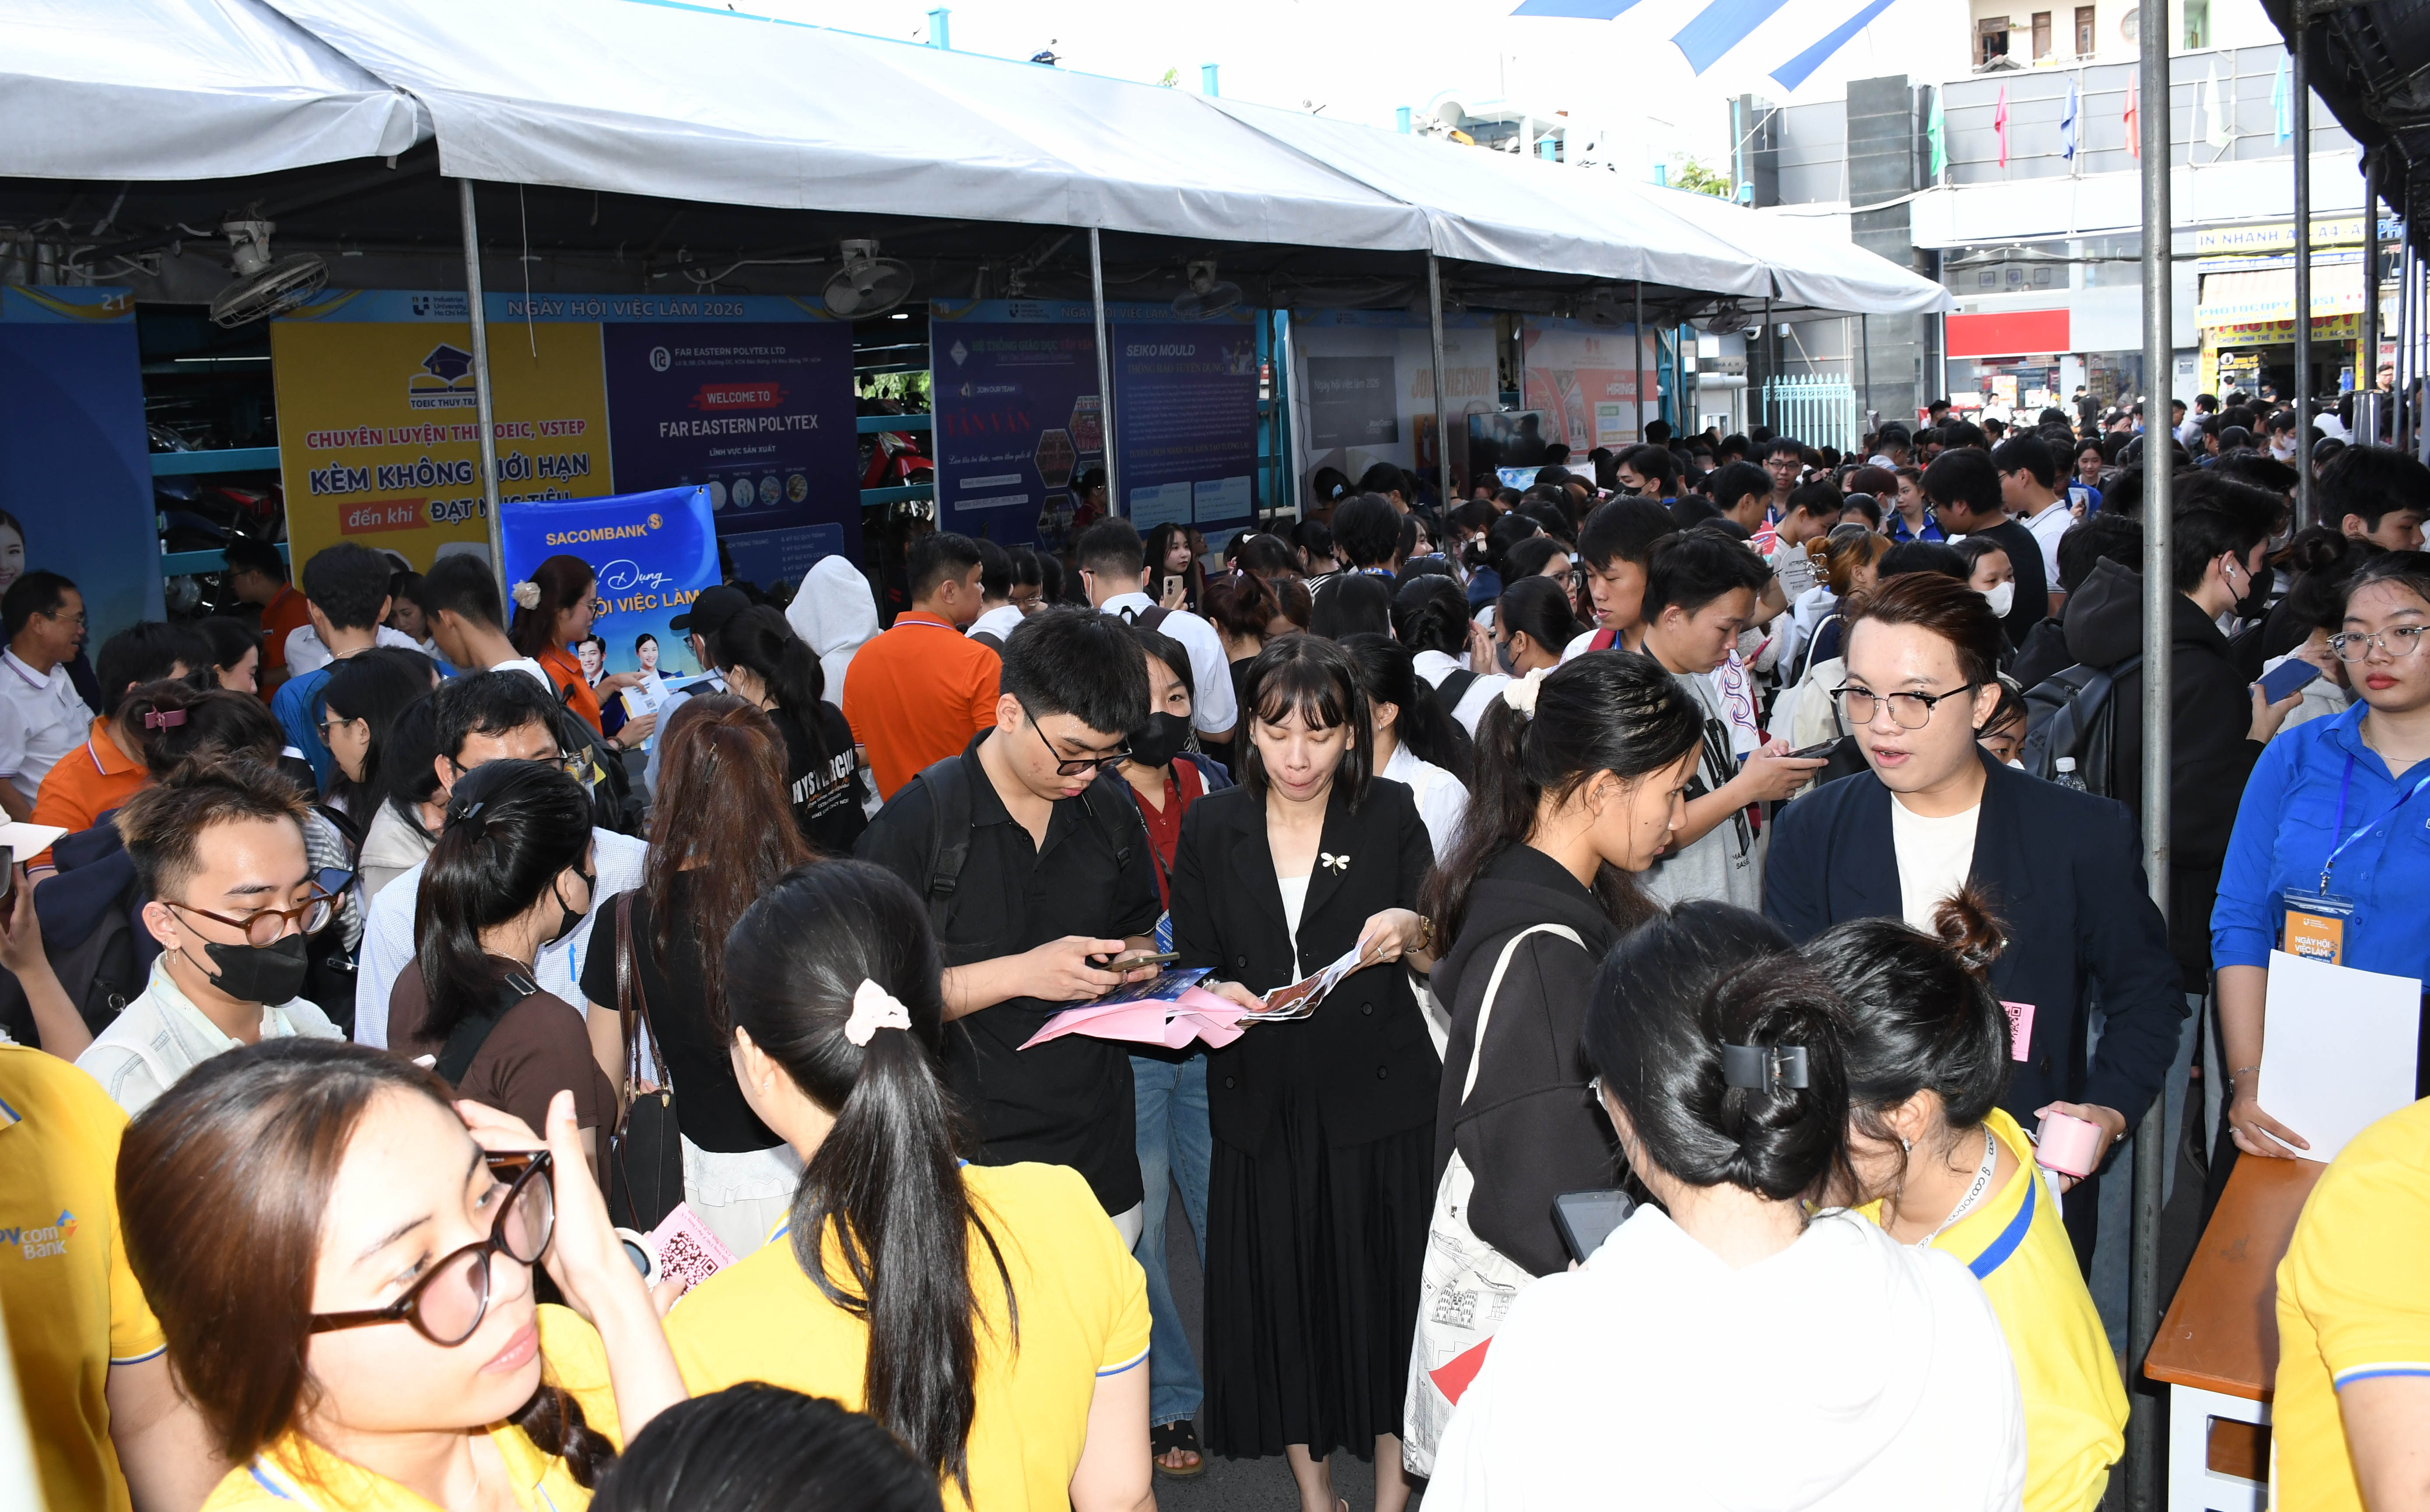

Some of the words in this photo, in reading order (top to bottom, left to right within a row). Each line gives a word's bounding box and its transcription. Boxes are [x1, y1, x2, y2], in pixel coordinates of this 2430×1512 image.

[2200, 236, 2215, 246] IN
[2222, 230, 2278, 244] NHANH
[2319, 226, 2338, 238] A4
[101, 294, 126, 310] 21
[508, 297, 564, 316] NGÀY
[571, 298, 607, 320] HỘI
[614, 298, 654, 321] VIỆC
[660, 298, 697, 316] LÀM
[704, 303, 743, 316] 2026
[939, 303, 949, 313] 18
[2200, 301, 2290, 316] PHOTOCOPY
[675, 348, 692, 356] FAR
[694, 347, 731, 356] EASTERN
[733, 347, 769, 355] POLYTEX
[771, 346, 785, 355] LTD
[1127, 345, 1157, 357] SEIKO
[1159, 345, 1195, 356] MOULD
[1366, 378, 1380, 388] 2026
[411, 398, 436, 408] TOEIC
[438, 397, 460, 408] THUY
[707, 392, 755, 404] WELCOME
[757, 391, 770, 401] TO
[660, 422, 689, 438] FAR
[693, 417, 757, 435] EASTERN
[759, 415, 818, 432] POLYTEX
[944, 407, 984, 437] TÂN
[306, 425, 384, 449] CHUYÊN
[388, 422, 446, 446] LUYỆN
[451, 425, 478, 441] THI
[494, 422, 537, 442] OEIC,
[540, 420, 586, 436] VSTEP
[709, 447, 725, 457] LĨNH
[310, 460, 370, 494] KÈM
[377, 457, 473, 489] KHÔNG
[480, 450, 531, 481] IỚI
[537, 453, 589, 483] HẠN
[349, 505, 381, 527] đến
[387, 505, 413, 525] khi
[430, 499, 472, 524] ĐẠT
[546, 524, 648, 546] SACOMBANK
[594, 598, 613, 619] ỘI
[616, 592, 657, 614] VIỆC
[662, 587, 699, 608] LÀM
[811, 811, 823, 819] MAKE
[2295, 935, 2316, 946] NGÀY
[2317, 939, 2330, 949] HỘI
[2295, 944, 2311, 955] VIỆC
[2312, 946, 2328, 957] LÀM
[24, 1240, 67, 1260] Bank
